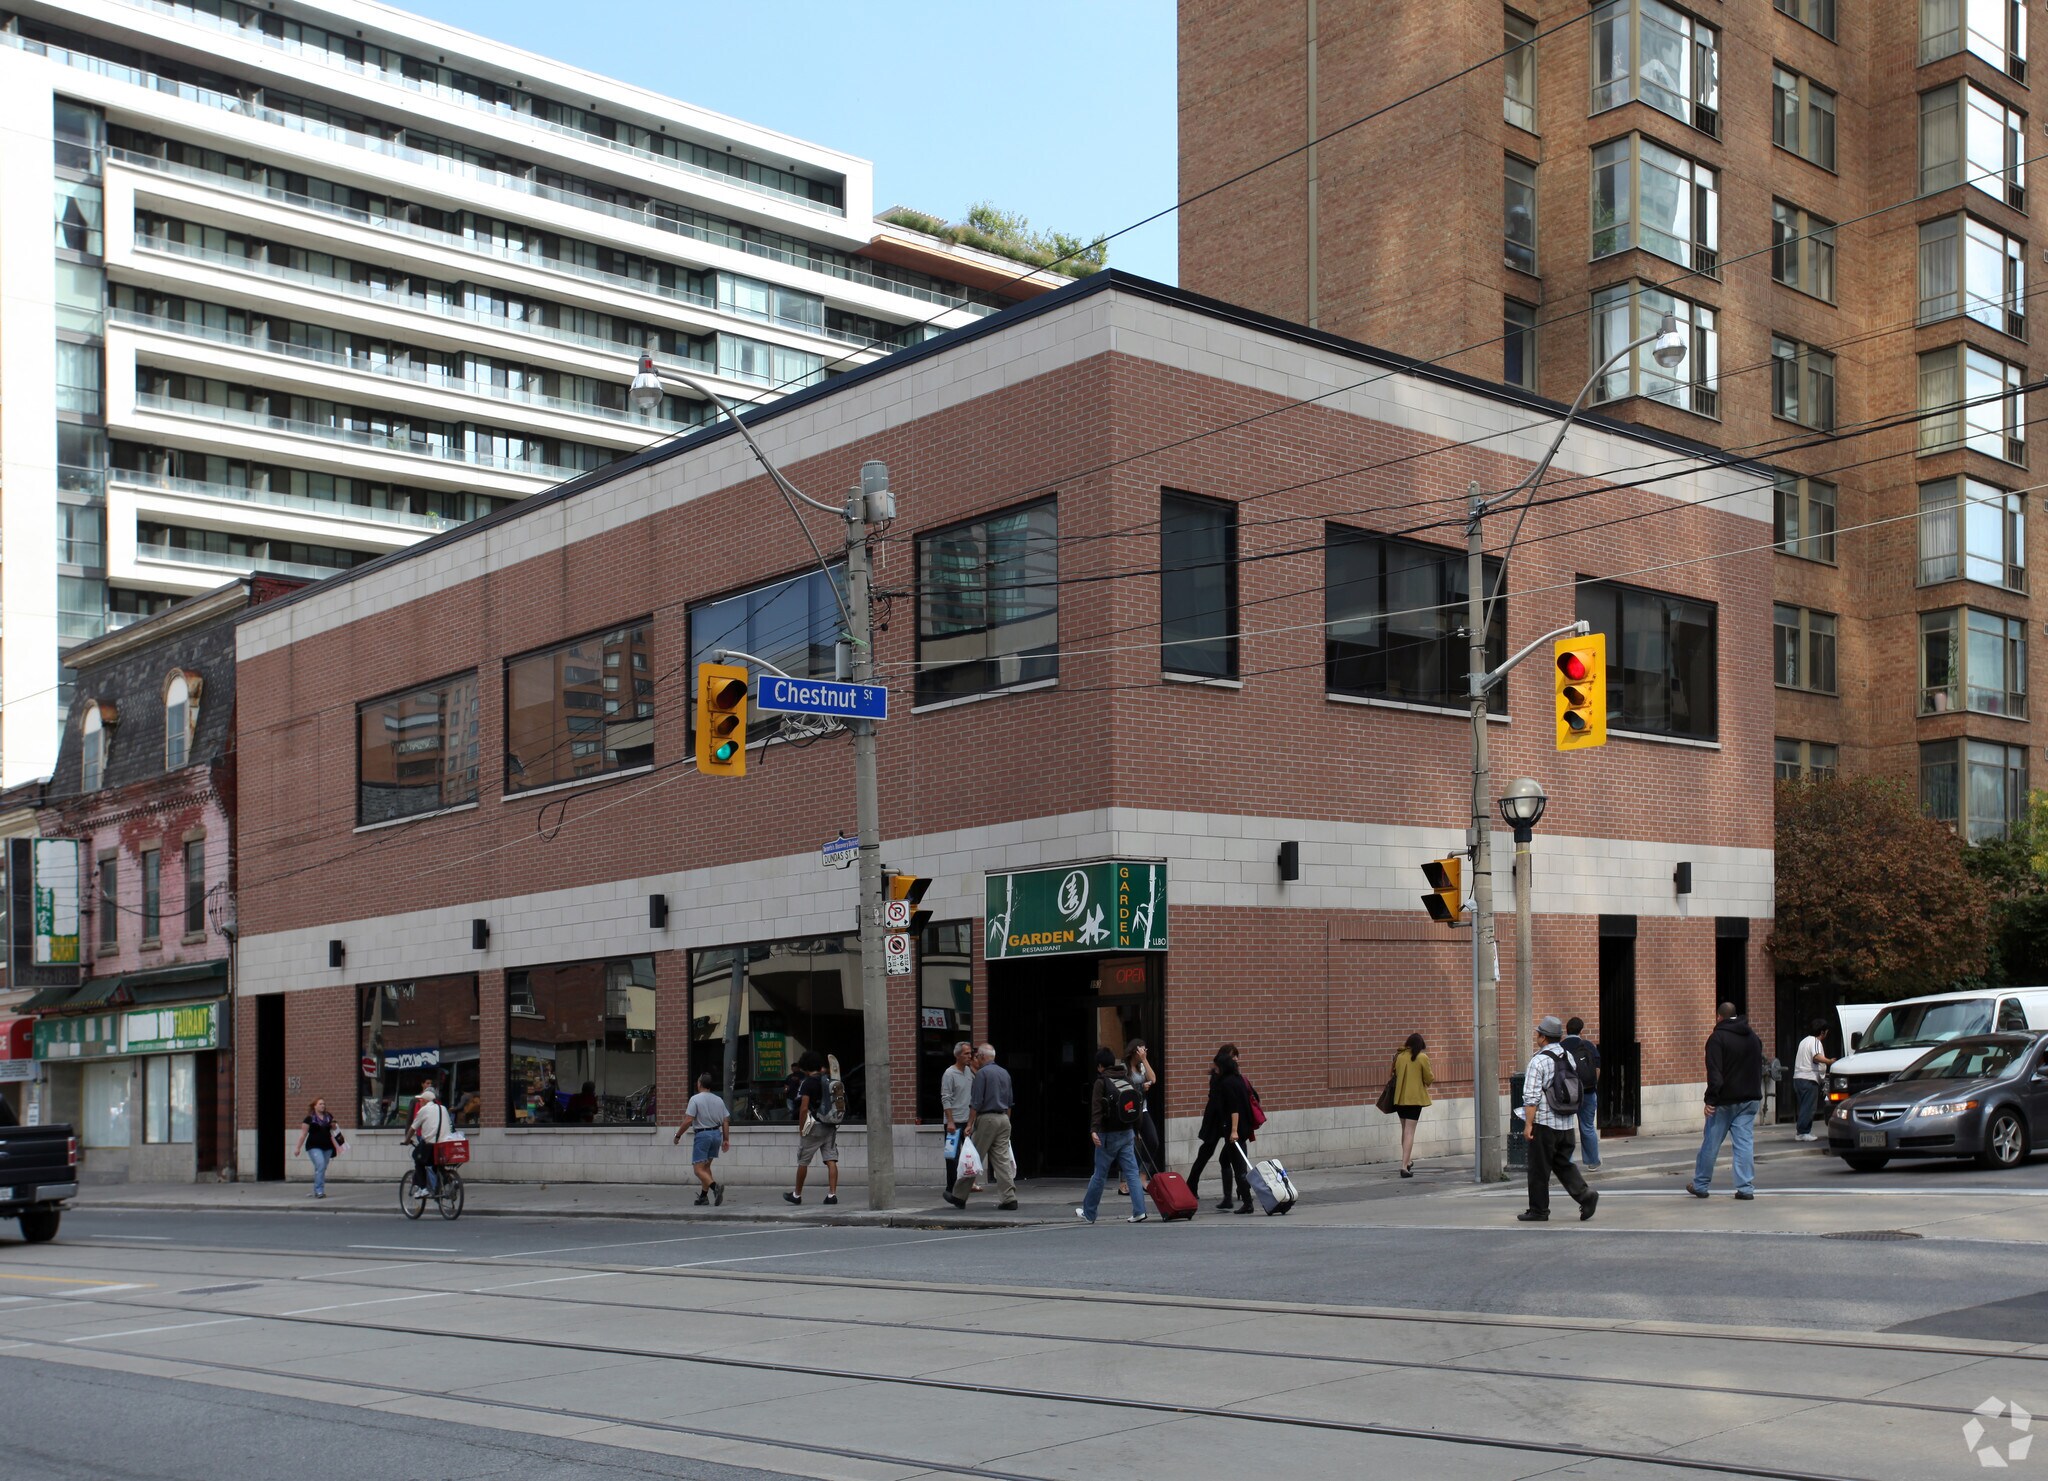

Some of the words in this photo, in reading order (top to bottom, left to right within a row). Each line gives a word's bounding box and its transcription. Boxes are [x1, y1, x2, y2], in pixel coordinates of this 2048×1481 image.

[774, 680, 857, 709] Chestnut
[863, 689, 873, 700] St
[824, 851, 844, 864] DUNDAS
[845, 850, 852, 860] ST
[1119, 867, 1130, 946] GARDEN
[1008, 930, 1075, 947] GARDEN
[1152, 937, 1167, 946] LLBO
[1022, 945, 1061, 953] RESTAURANT
[1116, 968, 1145, 984] OPEN
[173, 1007, 208, 1037] TAURANT
